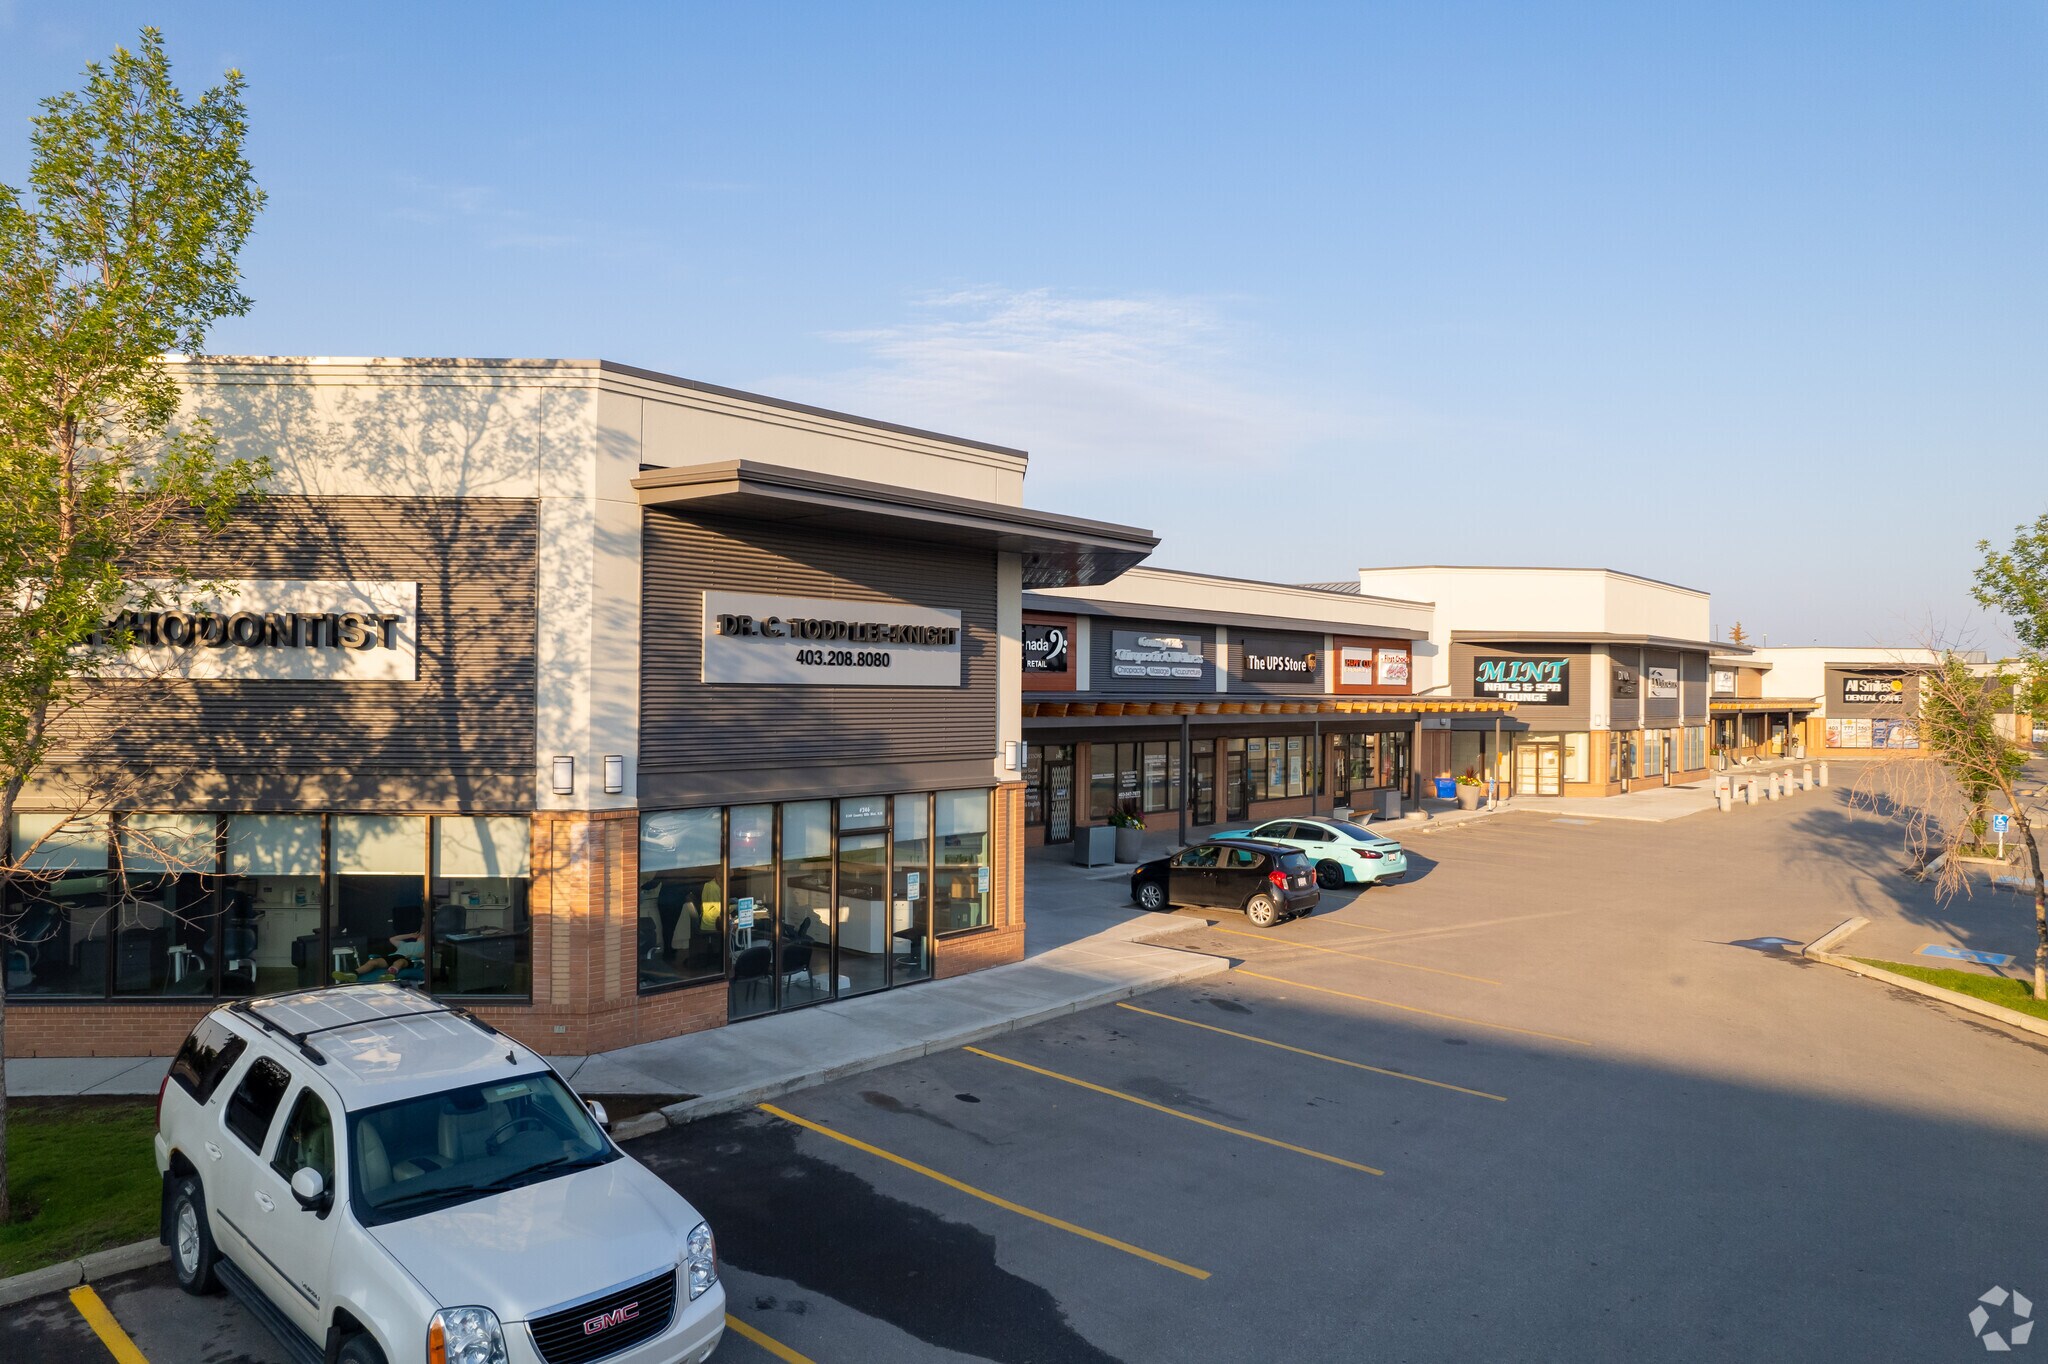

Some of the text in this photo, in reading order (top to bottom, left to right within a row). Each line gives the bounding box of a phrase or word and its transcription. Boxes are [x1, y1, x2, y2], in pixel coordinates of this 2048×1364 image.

[716, 613, 960, 646] DR. C. TODD LEE-KNIGHT
[1025, 638, 1049, 651] nada
[796, 649, 891, 668] 403.208.8080
[1027, 660, 1047, 668] RETAIL
[1248, 655, 1265, 670] The
[1266, 655, 1283, 671] UPS
[1284, 656, 1306, 672] Store
[1150, 667, 1169, 676] Massage
[1475, 658, 1569, 682] MINT
[1484, 682, 1562, 692] NAILS & SPA
[1845, 680, 1891, 692] All Smiles
[1845, 694, 1903, 702] DENTAL CARE
[583, 1301, 640, 1335] GMC
